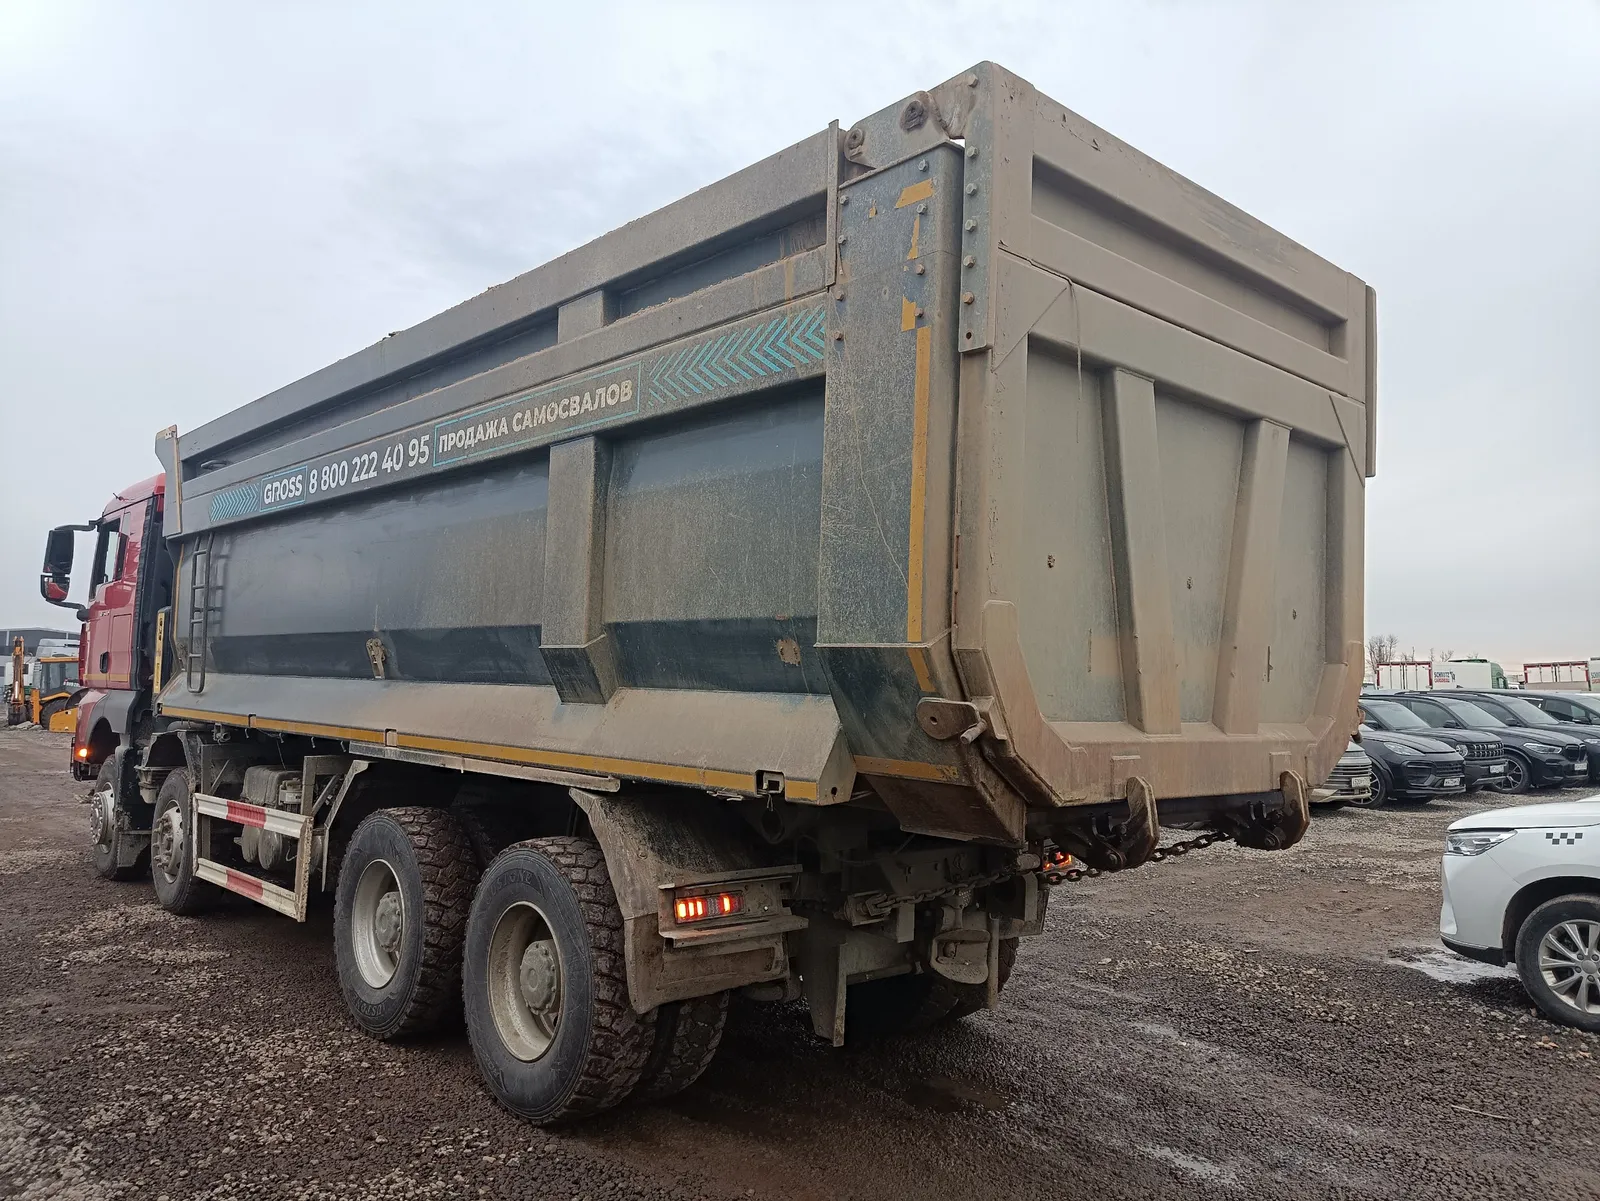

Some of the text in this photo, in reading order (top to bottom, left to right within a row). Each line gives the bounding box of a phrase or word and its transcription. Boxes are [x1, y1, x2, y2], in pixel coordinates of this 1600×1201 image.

[438, 379, 633, 454] ПРОДАЖА САМОСВАЛОВ
[263, 434, 430, 504] GROSS 8 800 222 40 95
